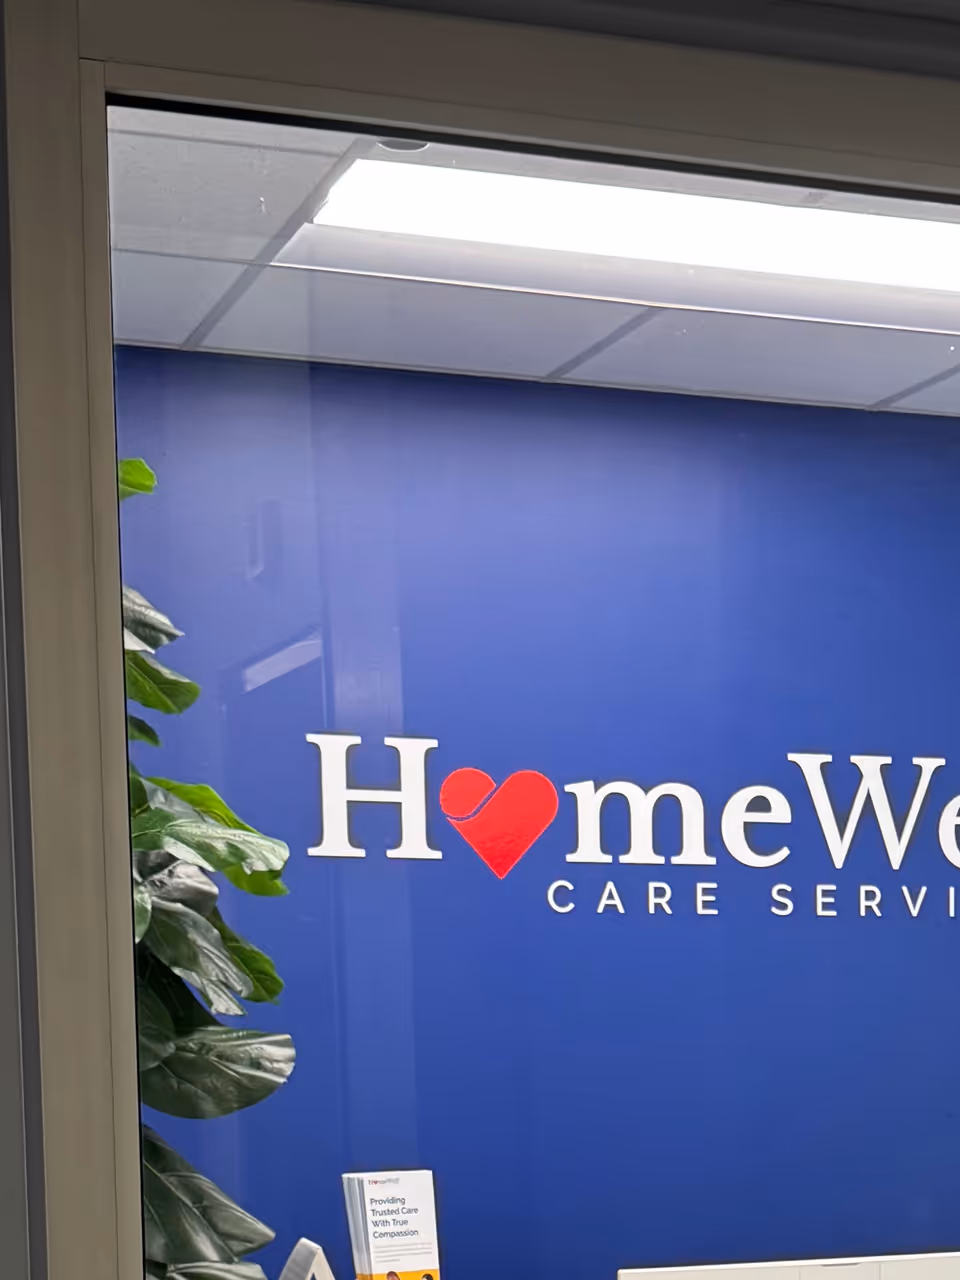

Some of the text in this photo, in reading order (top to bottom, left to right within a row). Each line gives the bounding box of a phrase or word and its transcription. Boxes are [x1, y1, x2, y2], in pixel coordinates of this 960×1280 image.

[547, 880, 719, 915] CARE
[370, 1197, 406, 1206] Providing
[371, 1208, 400, 1217] Trusted
[371, 1220, 391, 1228] With
[373, 1229, 419, 1239] Compassion
